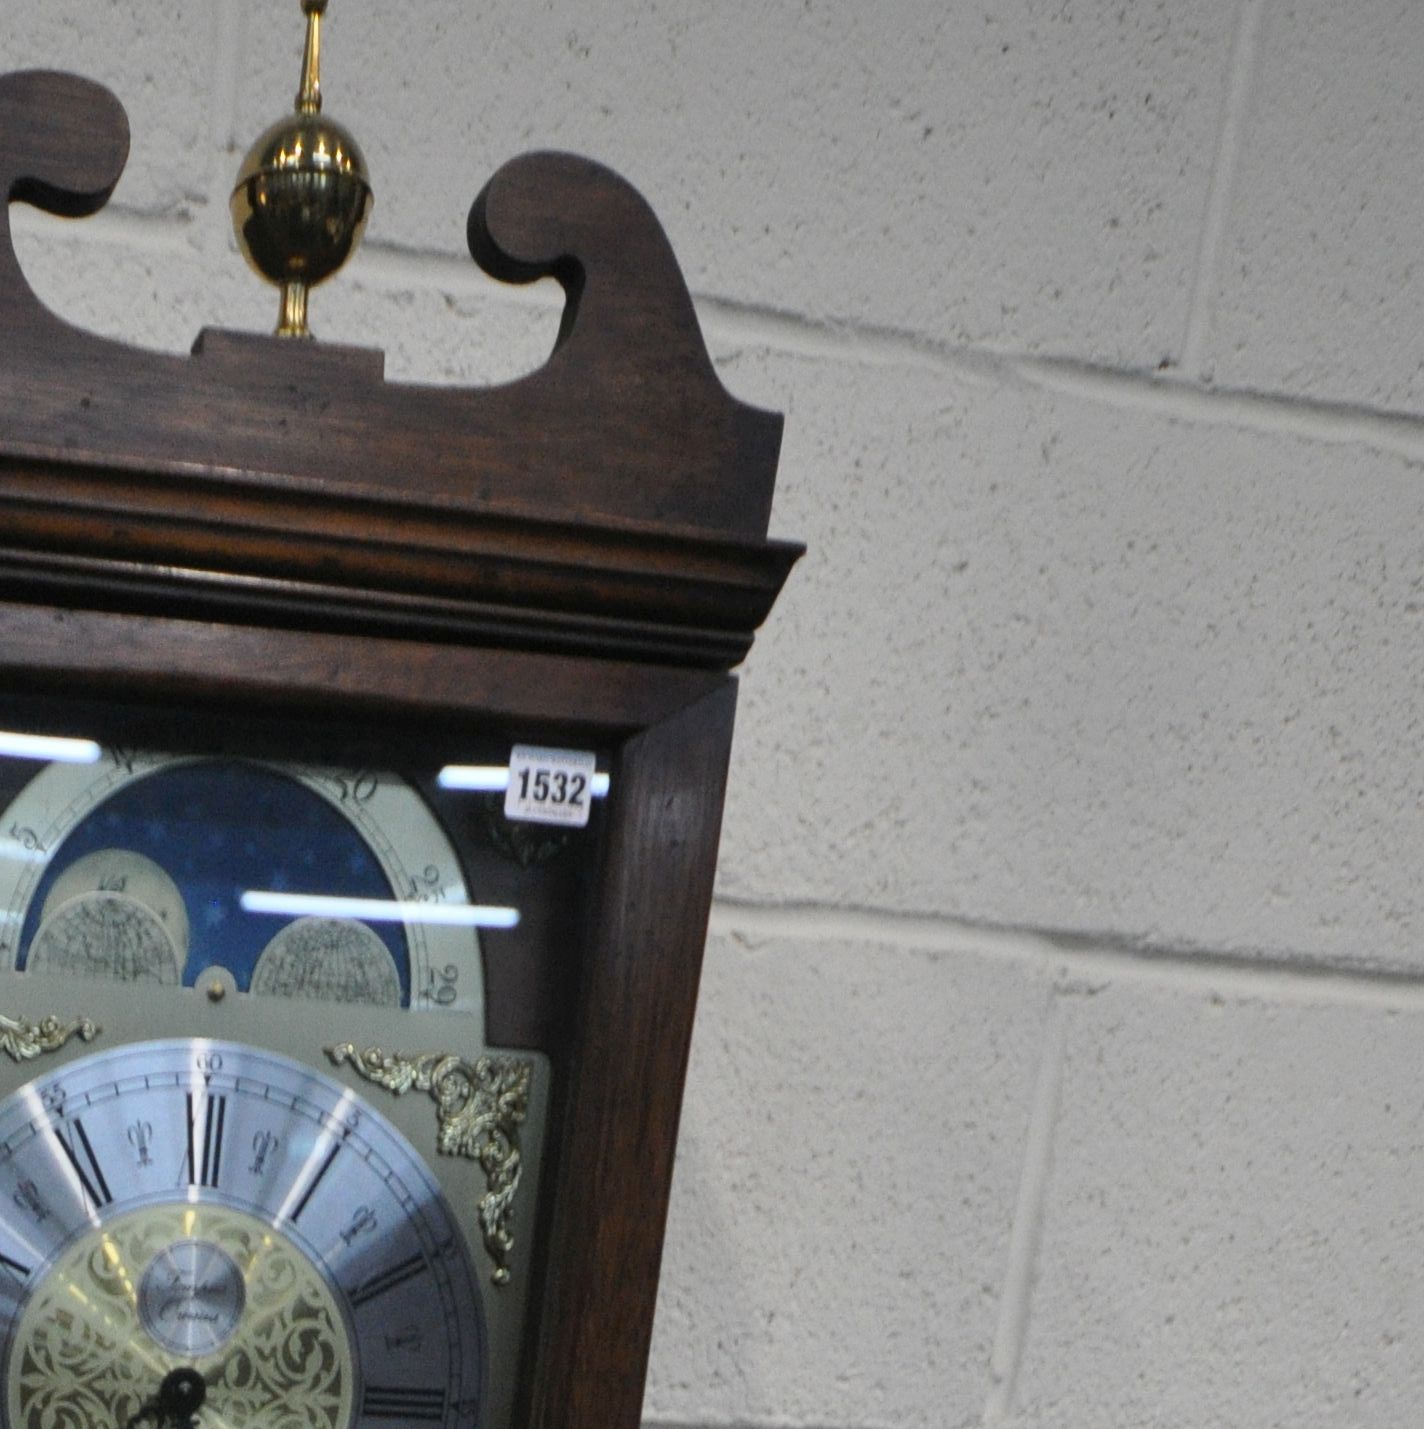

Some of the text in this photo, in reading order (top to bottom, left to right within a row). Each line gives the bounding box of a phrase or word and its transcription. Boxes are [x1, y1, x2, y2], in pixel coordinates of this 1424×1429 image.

[518, 767, 586, 806] 1532
[9, 821, 39, 851] 5
[196, 1052, 224, 1070] 60
[40, 1082, 67, 1104] 55
[345, 1109, 363, 1128] 5
[177, 1092, 226, 1188] XII
[55, 1118, 113, 1216] XI
[289, 1143, 342, 1223] I
[347, 1251, 429, 1309] II
[362, 1385, 446, 1421] III
